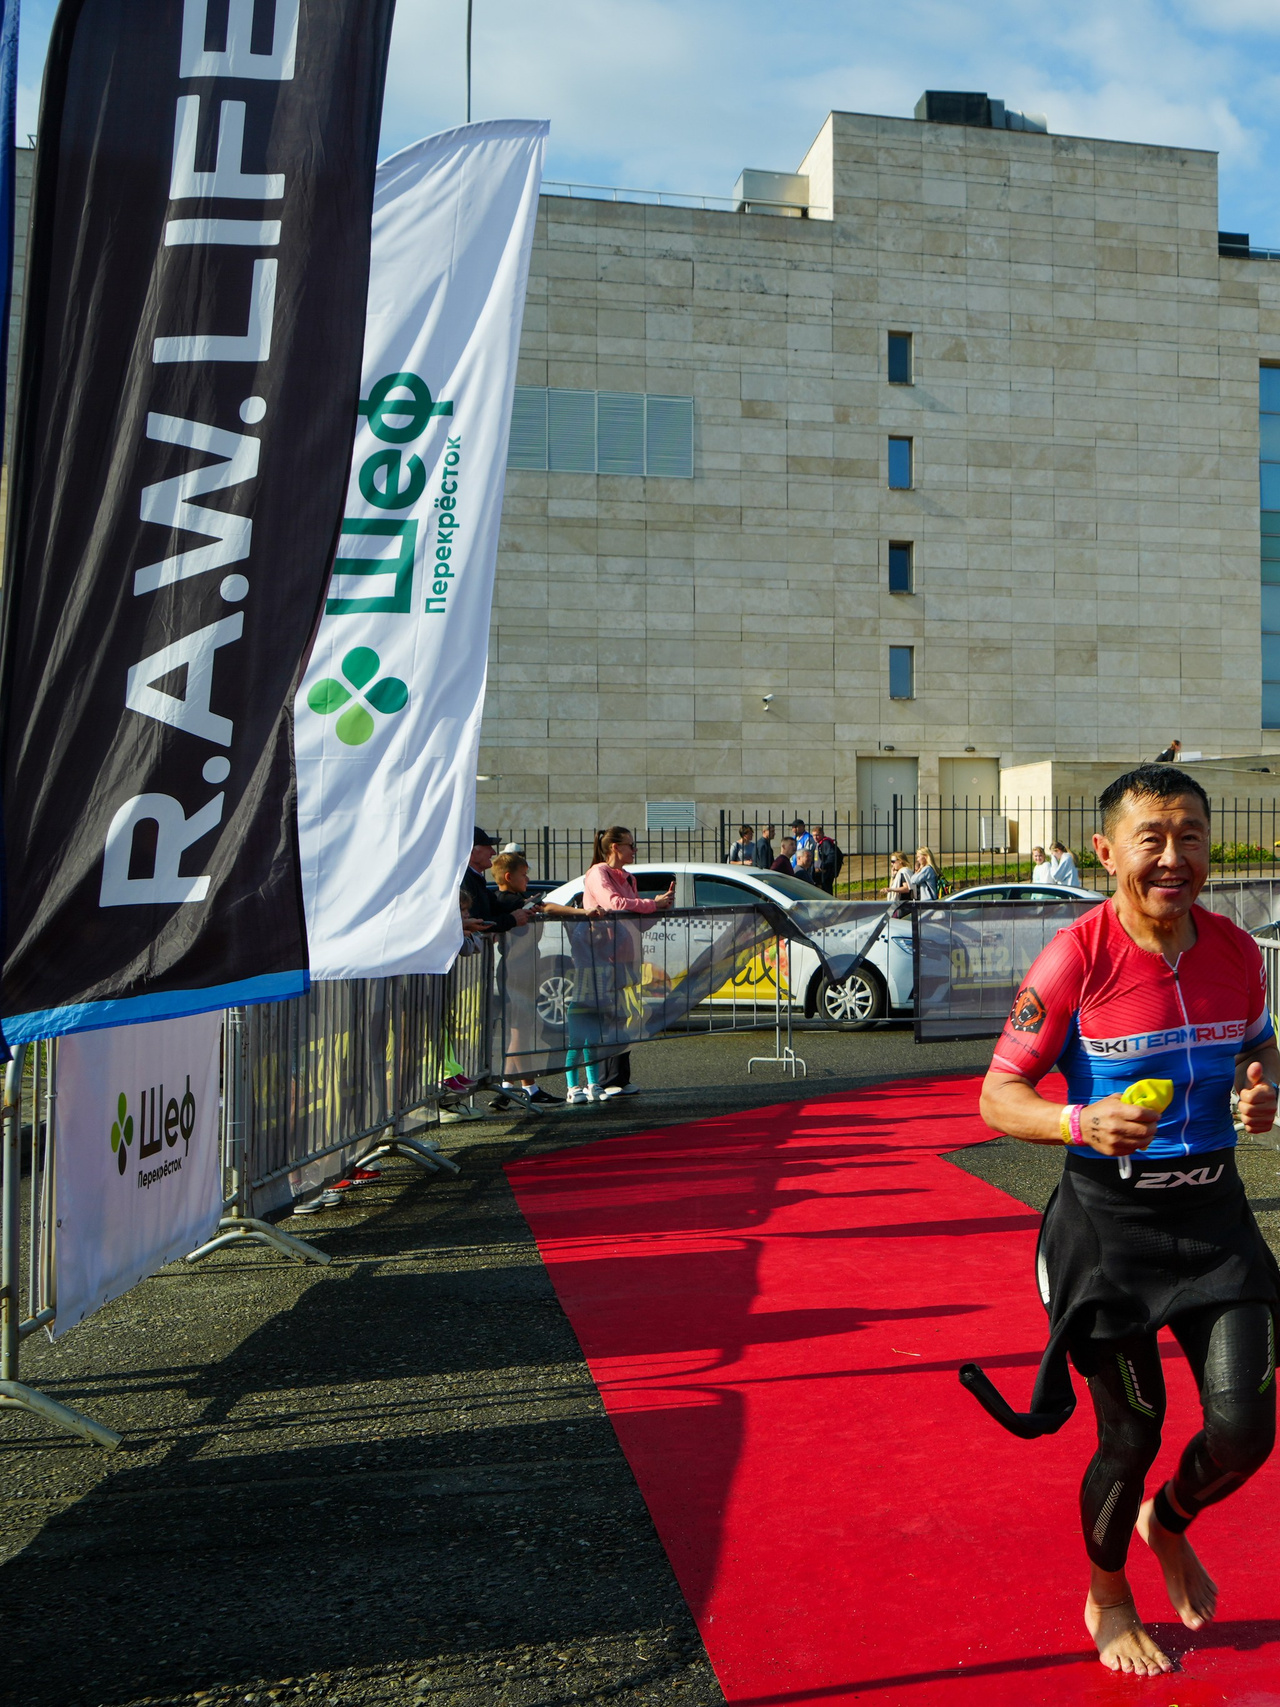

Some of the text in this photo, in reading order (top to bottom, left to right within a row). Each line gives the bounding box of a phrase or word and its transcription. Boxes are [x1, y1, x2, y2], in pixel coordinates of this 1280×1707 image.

[325, 372, 454, 616] Шеф
[425, 435, 462, 614] Перекрёсток
[642, 931, 677, 942] ндекс
[139, 1074, 196, 1160] Шеф
[137, 1157, 183, 1189] Перекрёсток
[1134, 1163, 1225, 1189] 2XU
